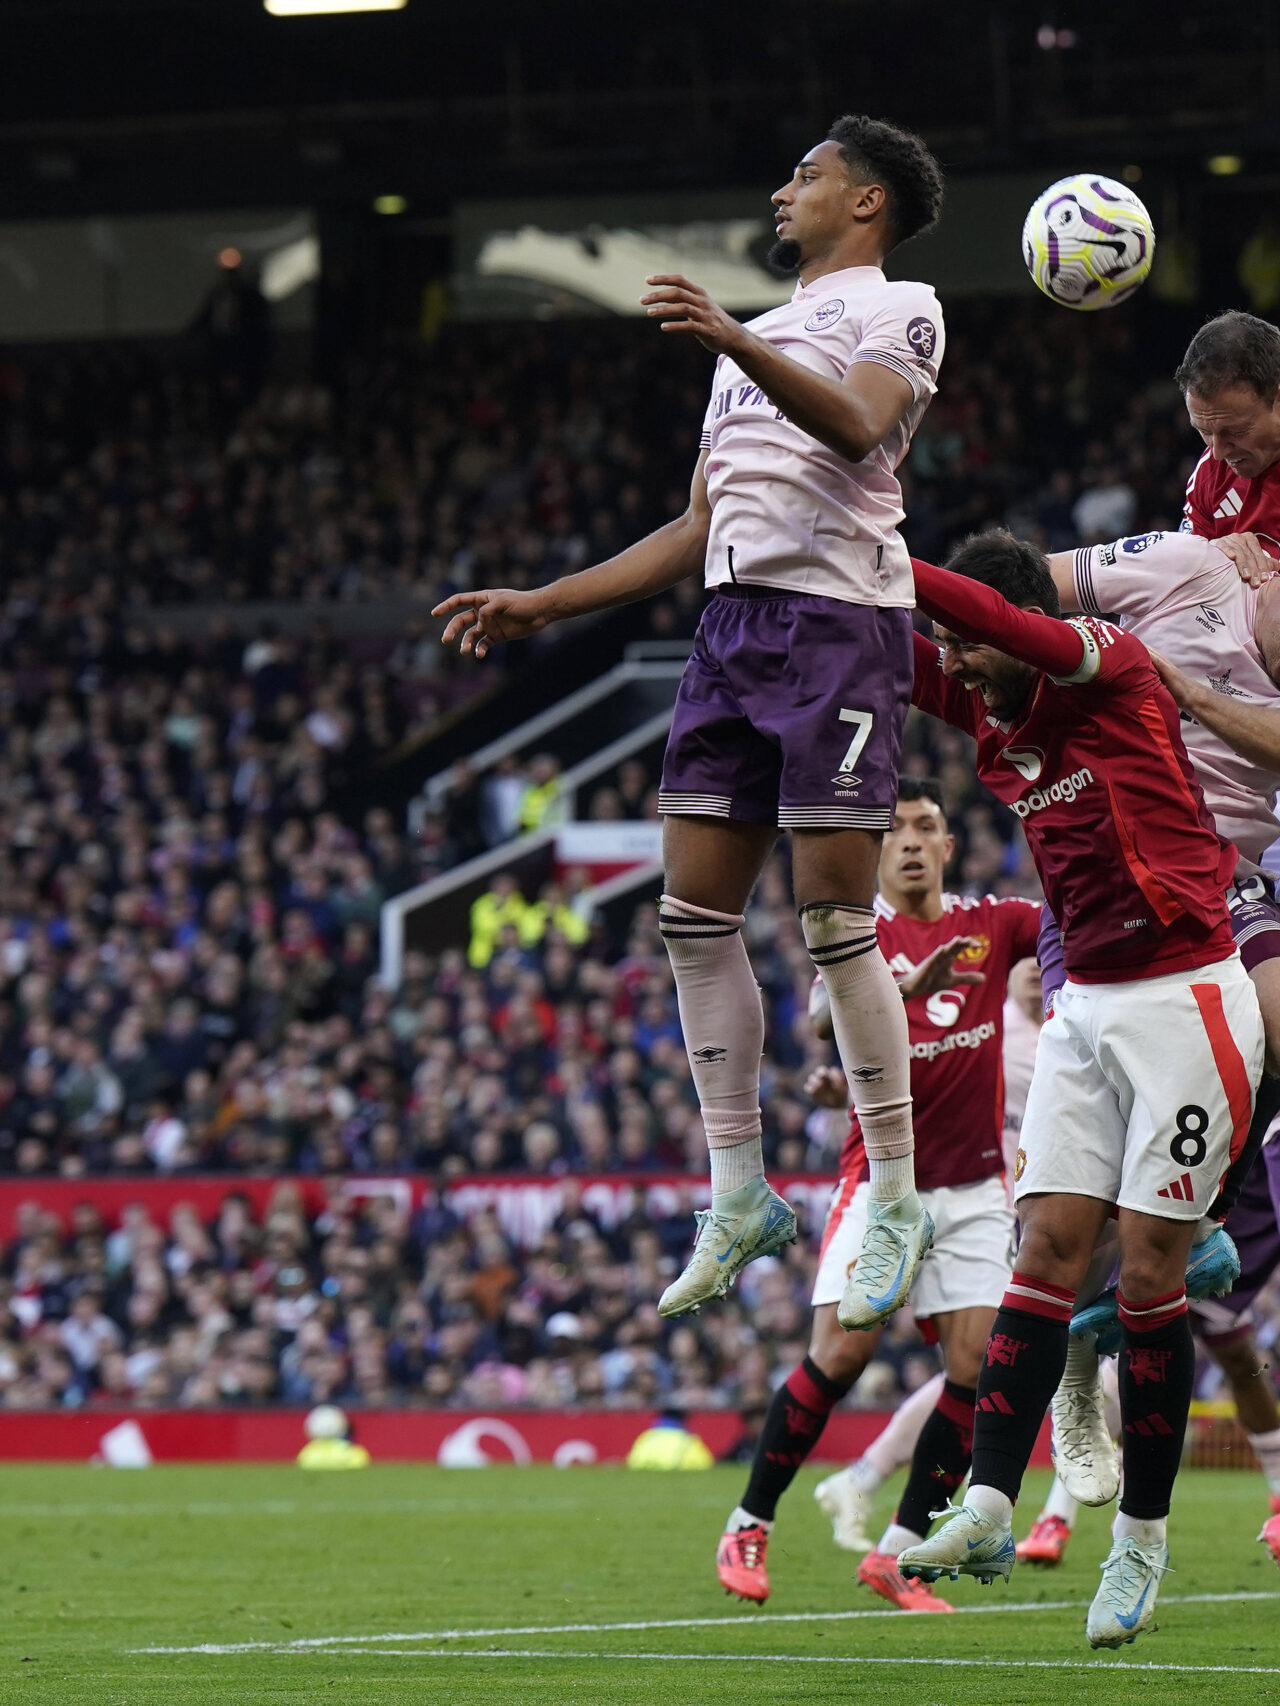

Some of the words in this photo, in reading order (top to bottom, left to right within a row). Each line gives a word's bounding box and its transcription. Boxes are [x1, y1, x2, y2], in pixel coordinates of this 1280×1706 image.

[1195, 615, 1216, 634] umbro
[838, 707, 873, 772] 7
[1241, 911, 1265, 921] umbro
[1170, 1105, 1209, 1167] 8
